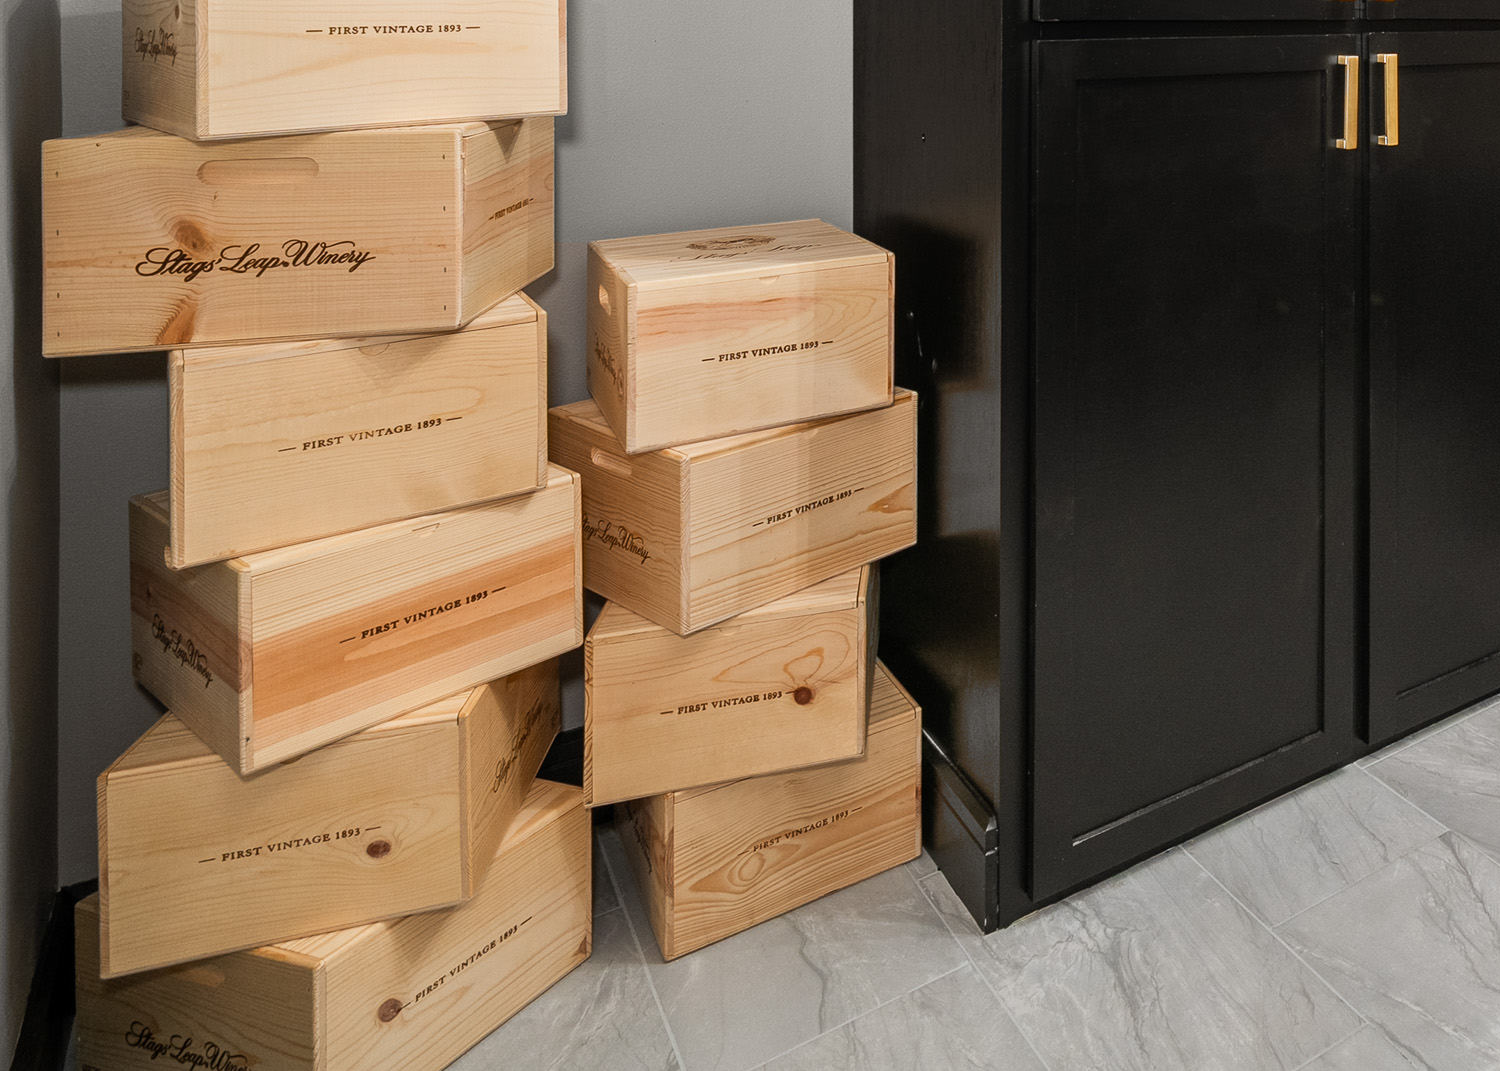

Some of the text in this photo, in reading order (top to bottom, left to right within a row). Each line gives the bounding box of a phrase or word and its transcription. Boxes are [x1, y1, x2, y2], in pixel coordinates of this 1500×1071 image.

[327, 24, 462, 35] FIRST VINTAGE 1893
[219, 243, 284, 278] Leap
[281, 239, 377, 273] Winery
[718, 340, 819, 362] FIRST VINTAGE 1893
[302, 417, 443, 451] FIRST VINTAGE 1893
[766, 489, 852, 525] FIRST VINTAGE 1893
[597, 520, 618, 551] Leap
[617, 525, 651, 565] Winery
[360, 590, 488, 640] FIRST VINTAGE 1893
[677, 690, 783, 715] FIRST VINTAGE 1893
[221, 827, 361, 862] FIRST VINTAGE 1893
[753, 809, 849, 852] FIRST VINTAGE 1893
[414, 925, 518, 1003] FIRST VINTAGE 1893
[169, 1034, 206, 1071] Leap
